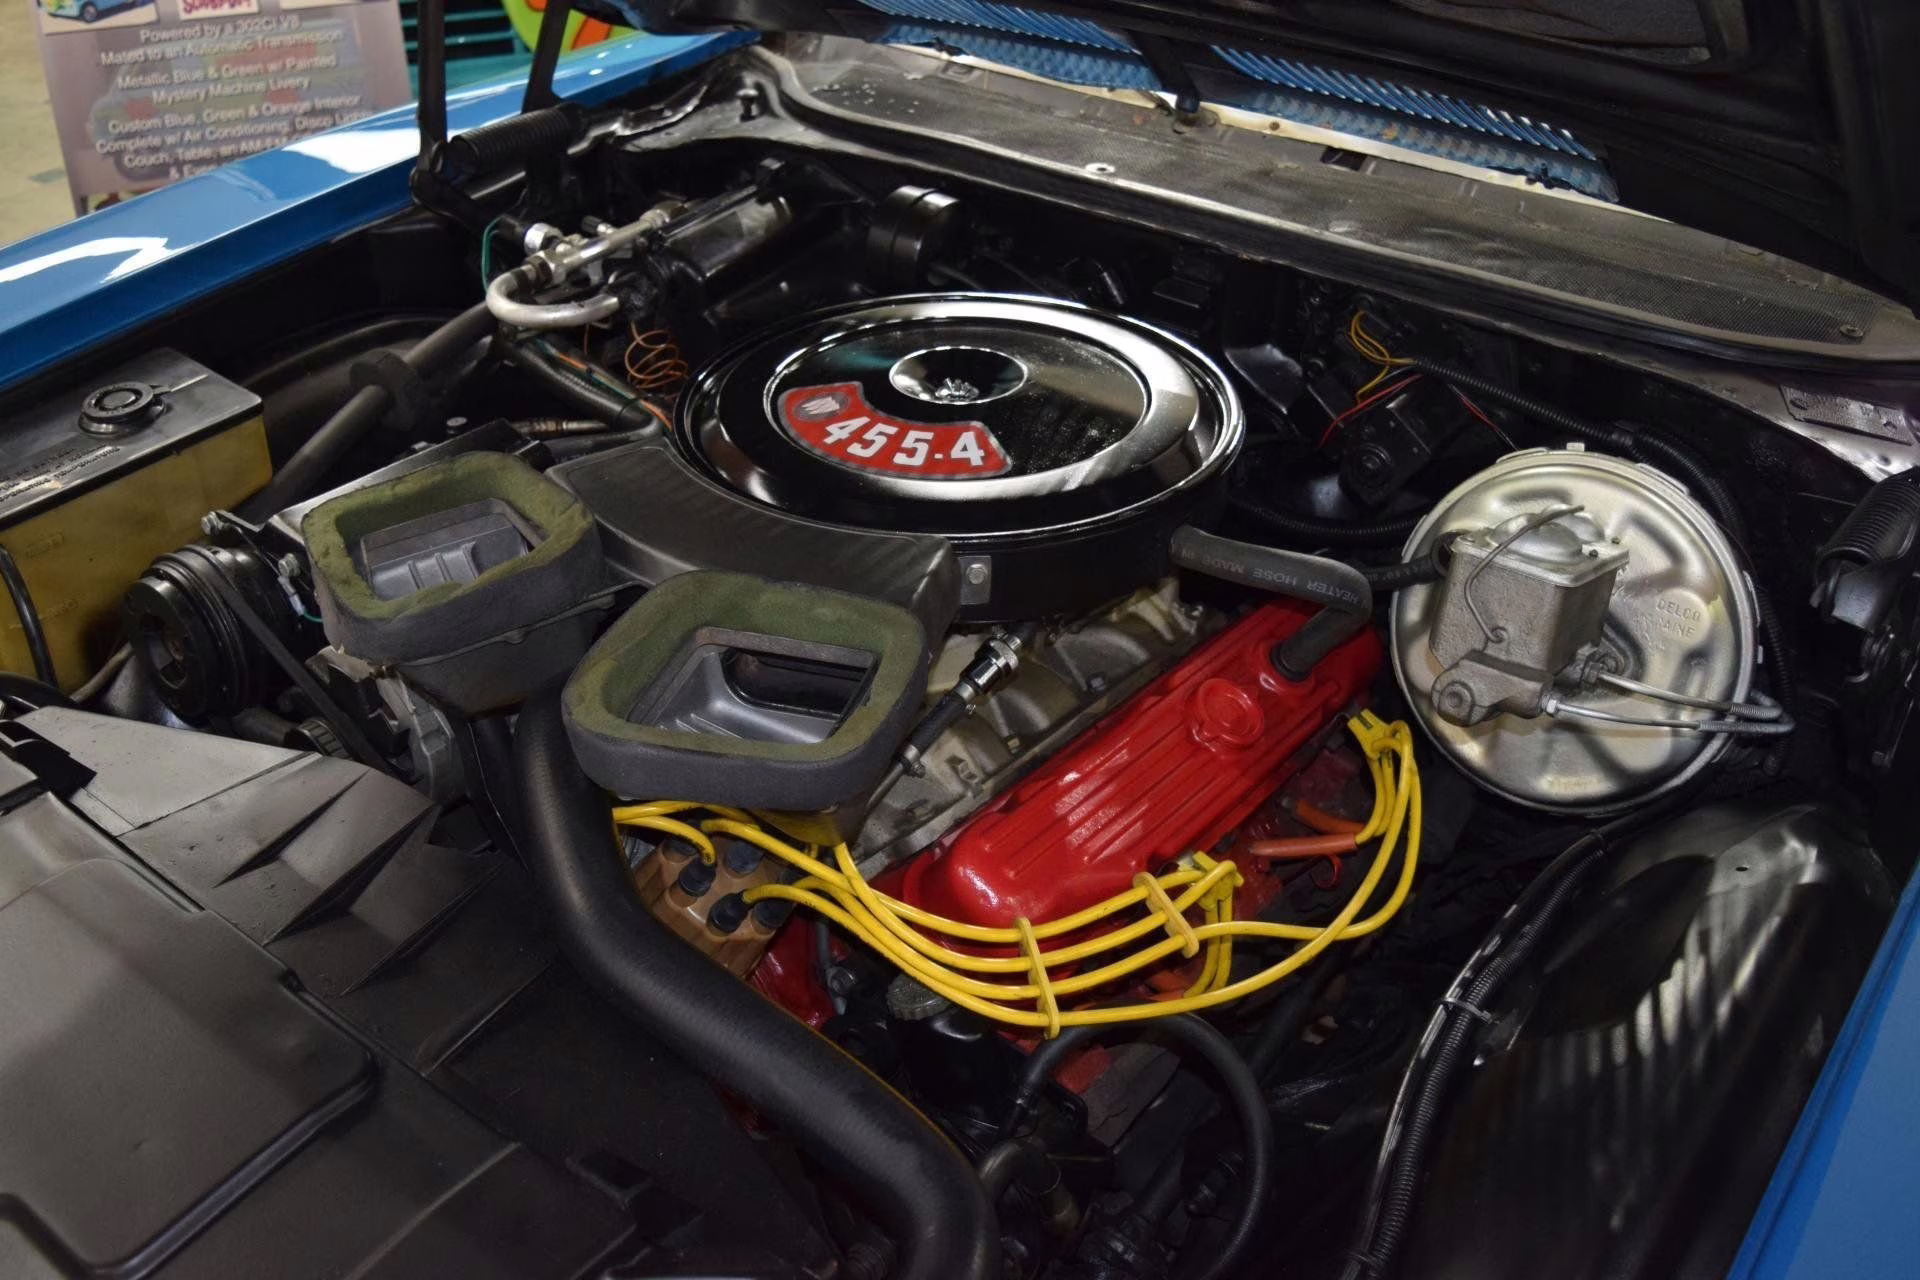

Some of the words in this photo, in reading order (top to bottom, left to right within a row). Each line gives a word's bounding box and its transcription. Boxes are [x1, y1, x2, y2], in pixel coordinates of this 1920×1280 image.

[140, 25, 201, 43] Powered
[202, 22, 219, 39] by
[100, 45, 146, 65] Mated
[147, 45, 162, 61] to
[117, 71, 171, 89] Metallic
[173, 67, 205, 84] Blue
[207, 65, 219, 79] &
[220, 60, 263, 79] Green
[285, 53, 336, 73] Painted
[151, 88, 208, 106] Mystery
[208, 80, 267, 98] Machine
[268, 75, 311, 92] Livery
[108, 116, 162, 135] Custom
[203, 105, 247, 123] Green
[248, 103, 260, 118] &
[261, 98, 313, 117] Orange
[95, 134, 162, 155] Complete
[294, 112, 334, 131] Disco
[1205, 555, 1245, 574] MADE
[1252, 567, 1298, 587] HOSE
[1306, 576, 1360, 604] HEATER
[1656, 598, 1702, 622] DELCO
